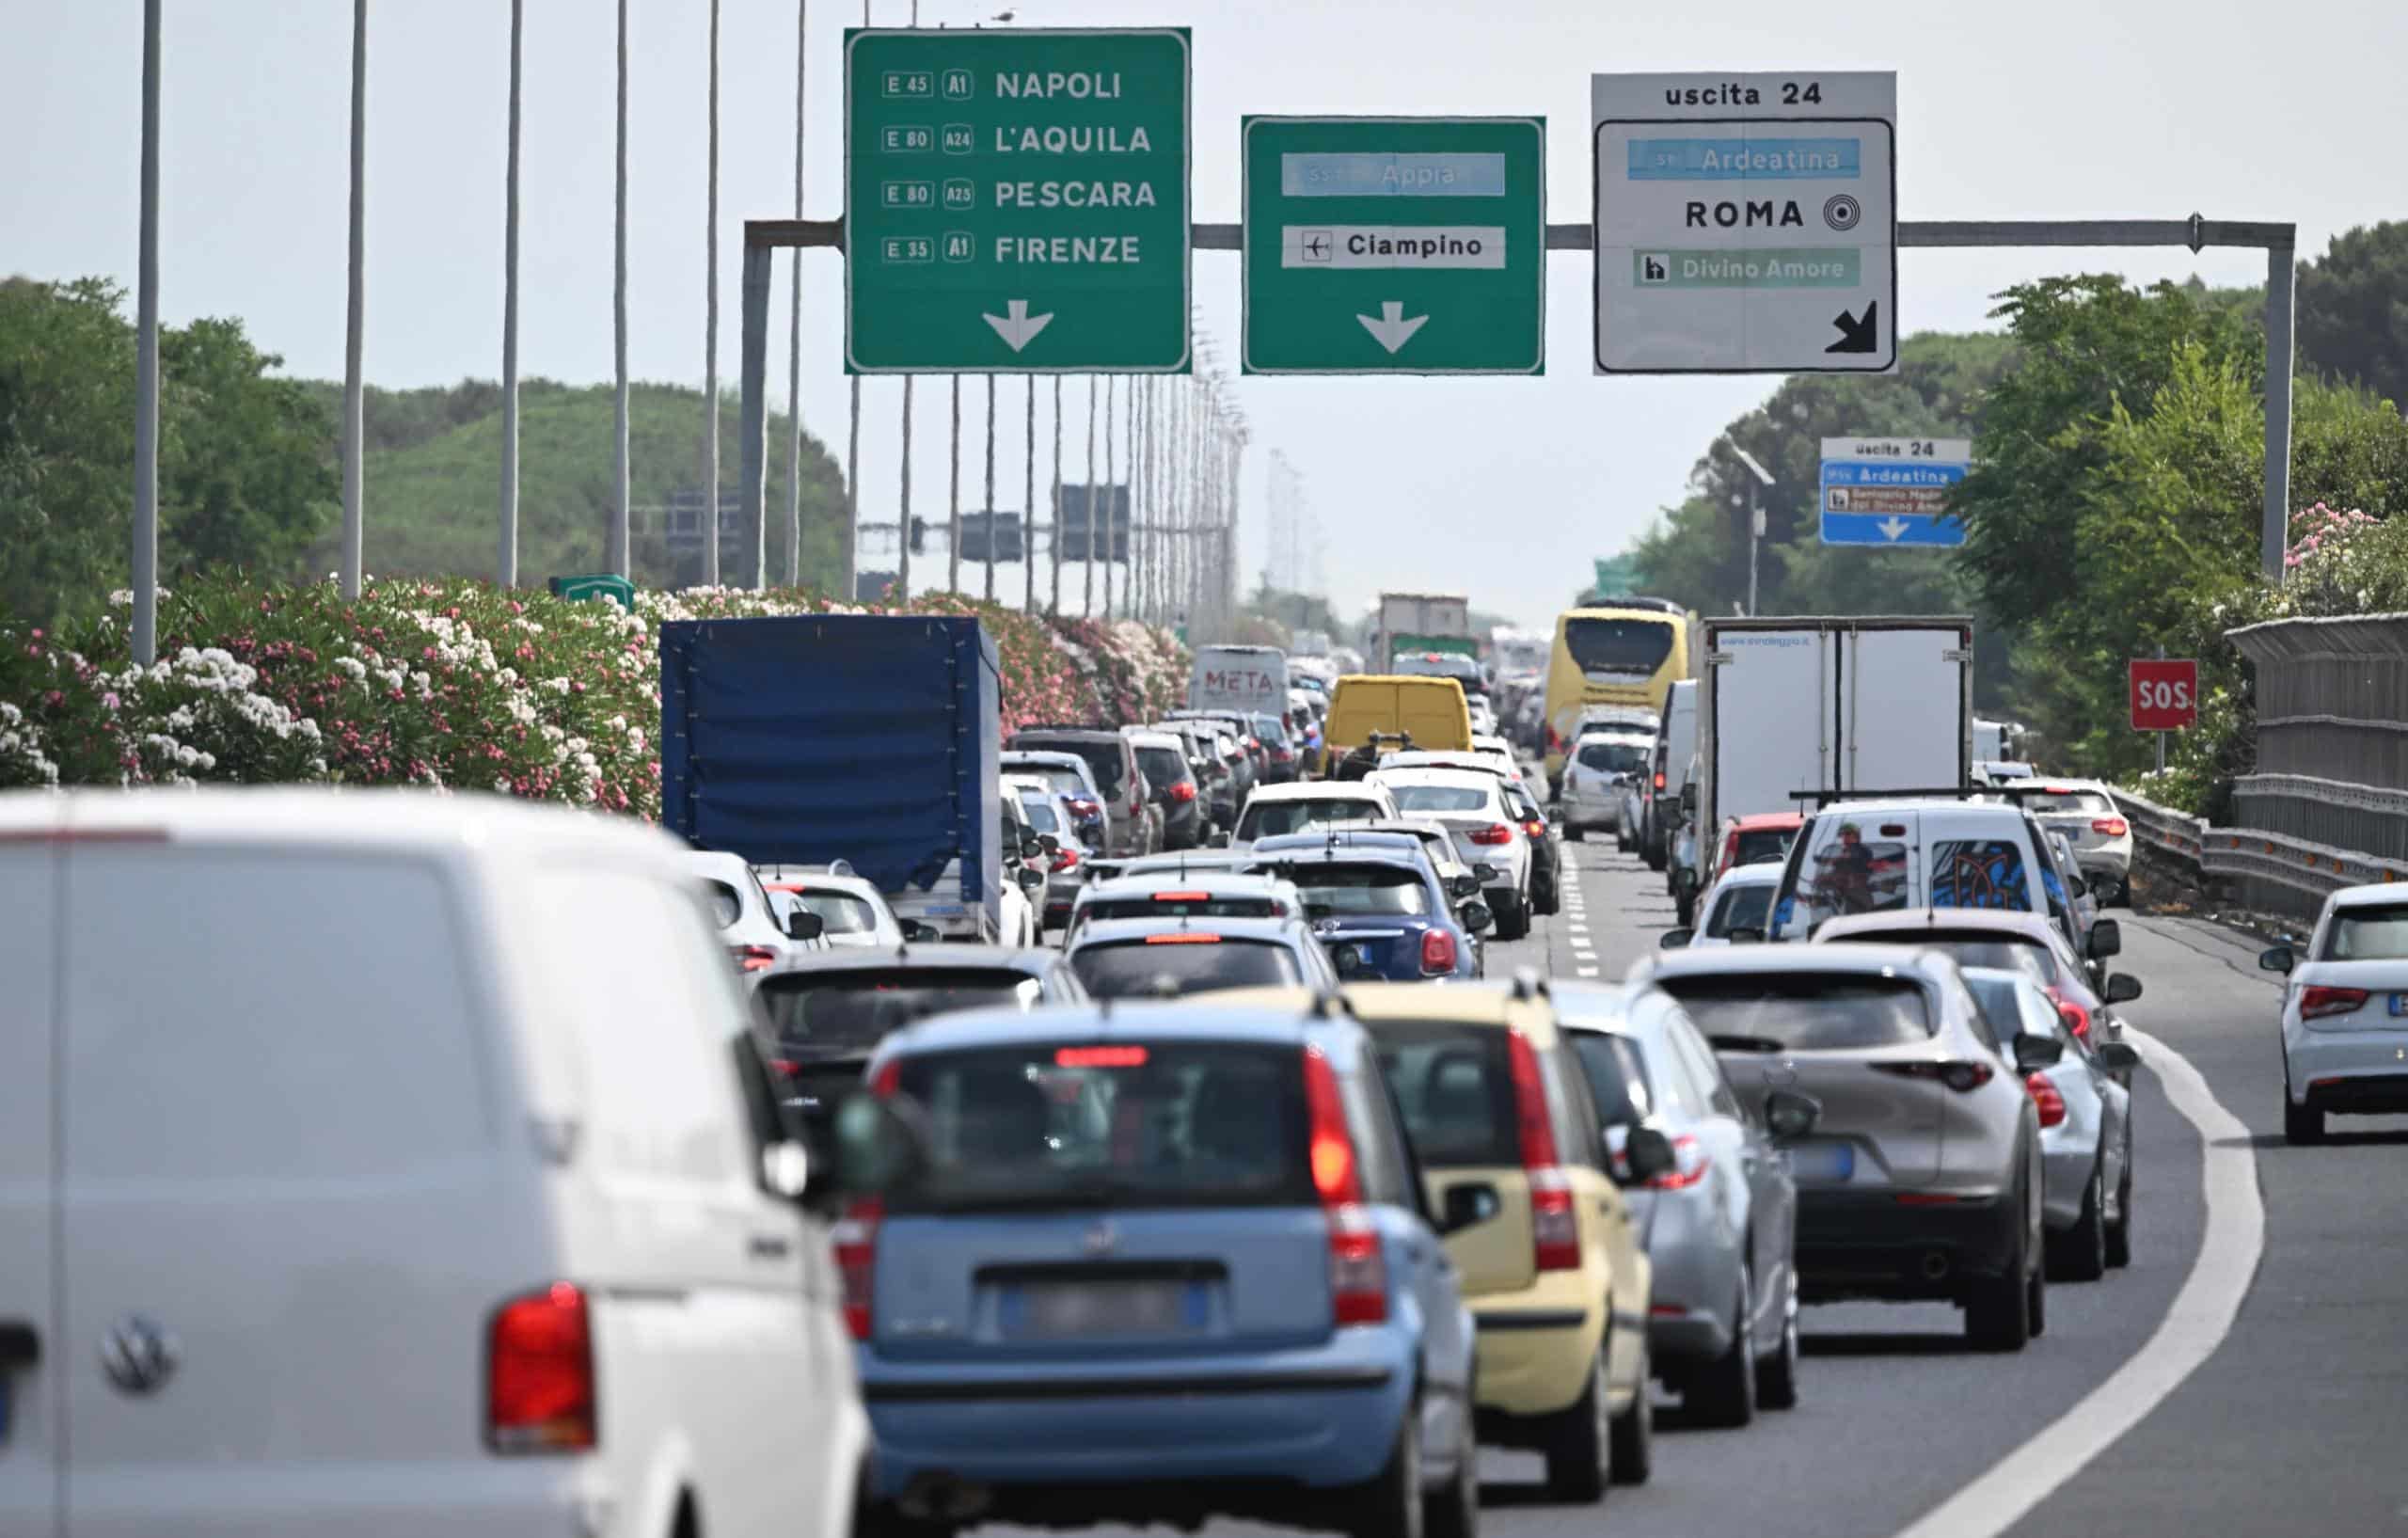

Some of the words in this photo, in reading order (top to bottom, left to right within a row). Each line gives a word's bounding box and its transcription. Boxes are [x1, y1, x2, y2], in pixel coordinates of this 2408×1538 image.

[887, 76, 899, 92] E
[907, 76, 927, 92] 45
[947, 75, 966, 93] A1
[995, 71, 1121, 99] NAPOLI
[1665, 82, 1760, 105] uscita
[1782, 82, 1822, 104] 24
[887, 131, 899, 148] E
[906, 131, 927, 148] 80
[945, 132, 971, 147] A24
[995, 126, 1152, 153] L'AQUILA
[1700, 148, 1840, 170] Ardeatina
[1382, 165, 1456, 187] Appia
[887, 185, 899, 203] E
[907, 185, 927, 203] 80
[946, 187, 972, 201] A25
[995, 181, 1156, 208] PESCARA
[1686, 200, 1804, 228] ROMA
[887, 242, 899, 258] E
[907, 241, 927, 258] 35
[948, 237, 968, 257] A1
[995, 236, 1141, 263] FIRENZE
[1347, 234, 1482, 259] Ciampino
[1683, 258, 1760, 279] Divino
[1766, 259, 1845, 279] Amore
[1856, 443, 1901, 456] uscita
[1910, 442, 1935, 457] 24
[1860, 468, 1949, 484] Ardeatina
[1206, 670, 1273, 691] META
[2138, 679, 2189, 709] SOS
